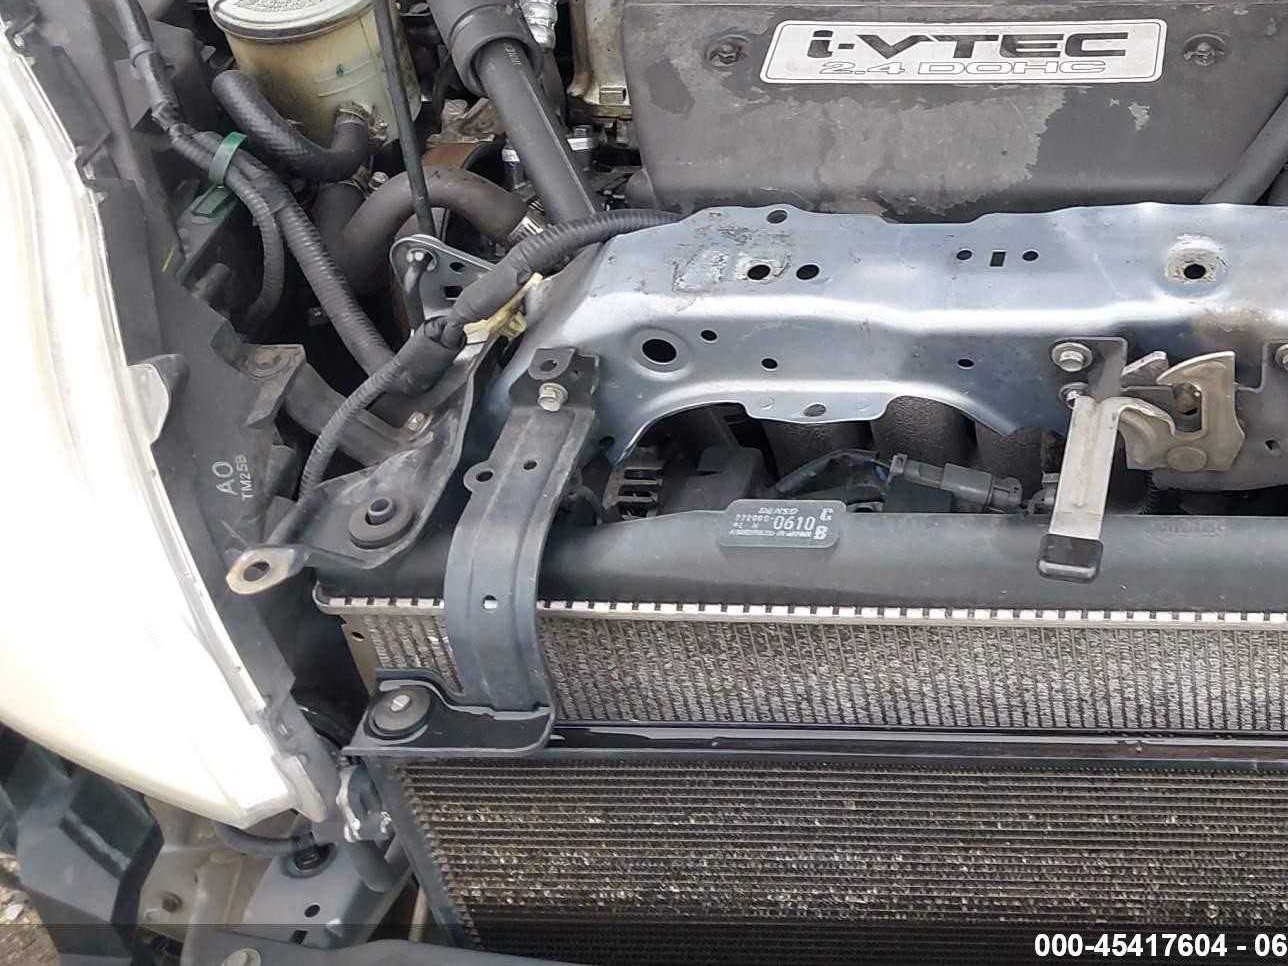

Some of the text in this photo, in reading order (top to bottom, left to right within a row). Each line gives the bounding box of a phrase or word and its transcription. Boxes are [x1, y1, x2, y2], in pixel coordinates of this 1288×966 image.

[807, 30, 1128, 59] i-VTEC
[819, 60, 1106, 75] 2.4 DOHC
